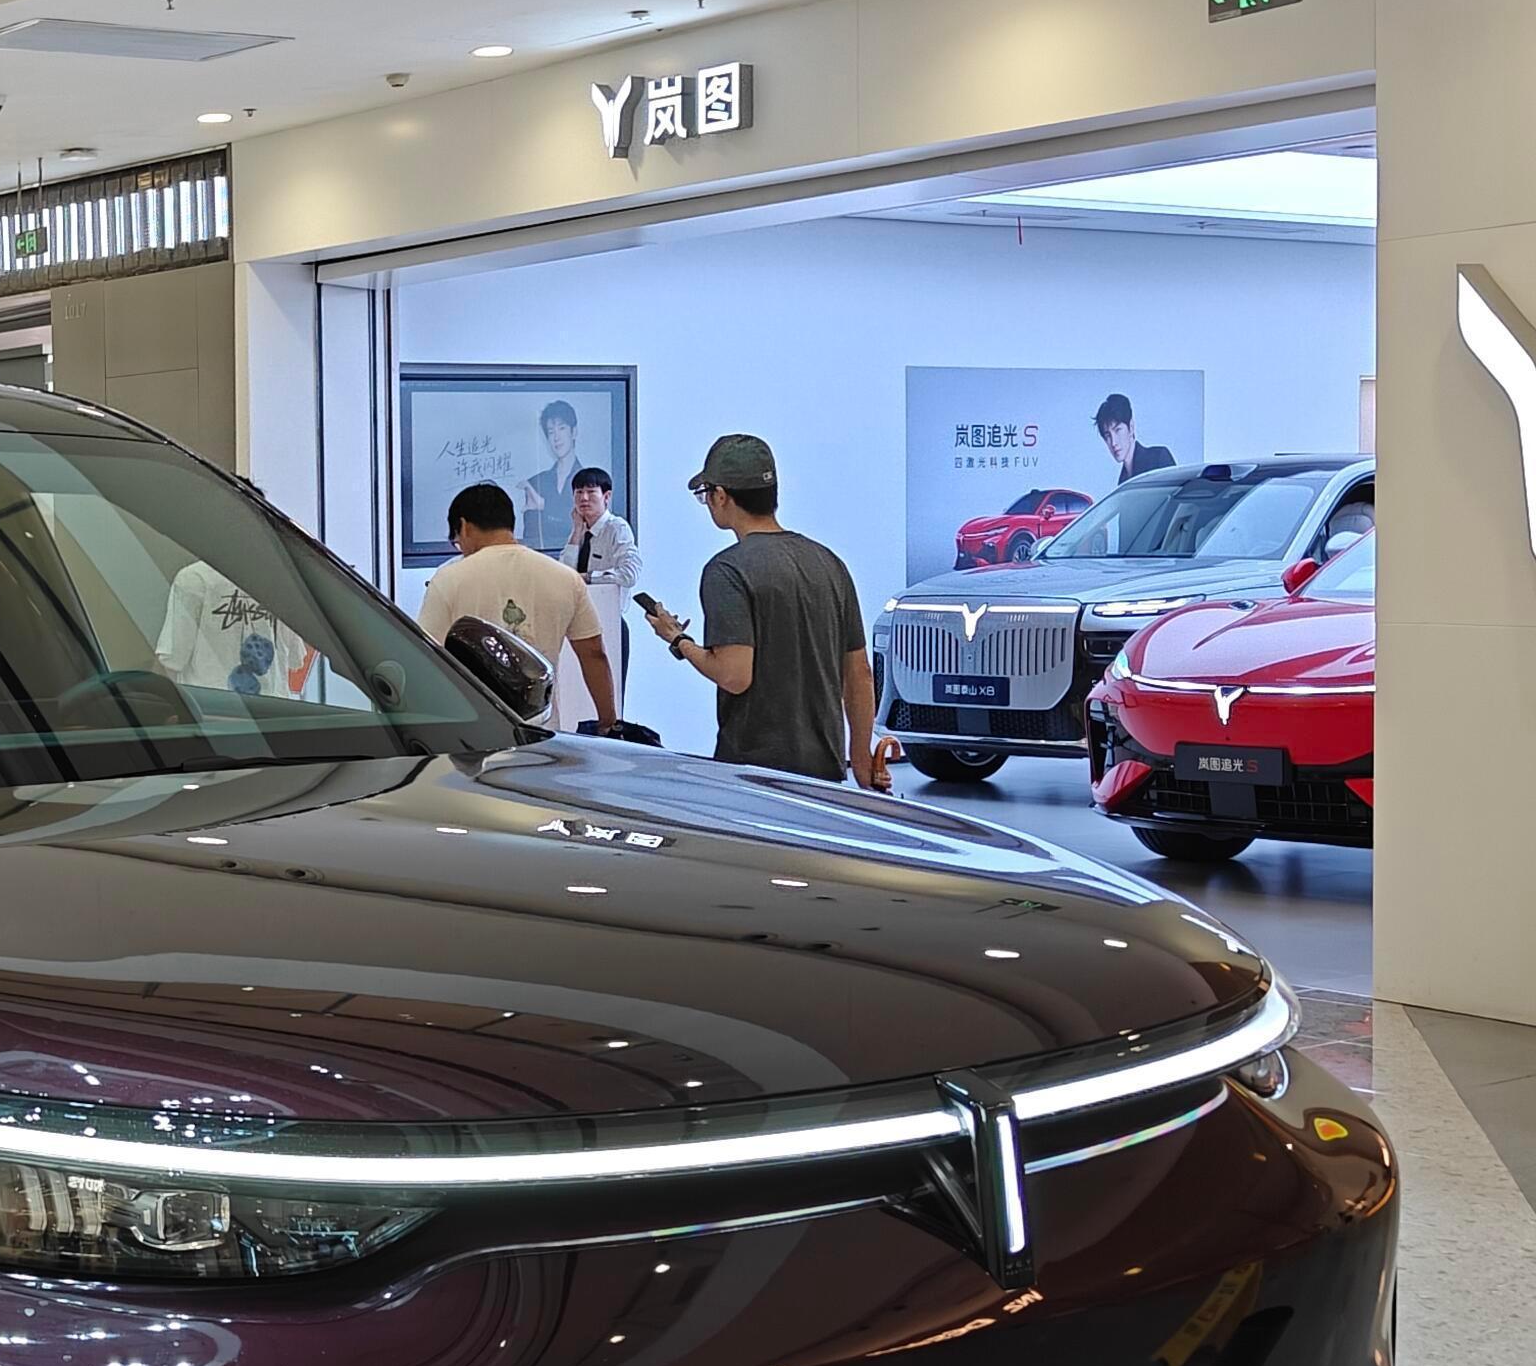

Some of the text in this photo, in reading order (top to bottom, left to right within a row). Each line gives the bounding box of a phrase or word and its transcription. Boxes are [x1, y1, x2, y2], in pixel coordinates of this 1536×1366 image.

[644, 62, 742, 146] 岚图
[436, 435, 497, 462] 人生追光
[954, 423, 1039, 448] 岚图追光 S
[1198, 757, 1244, 773] 岚图追光
